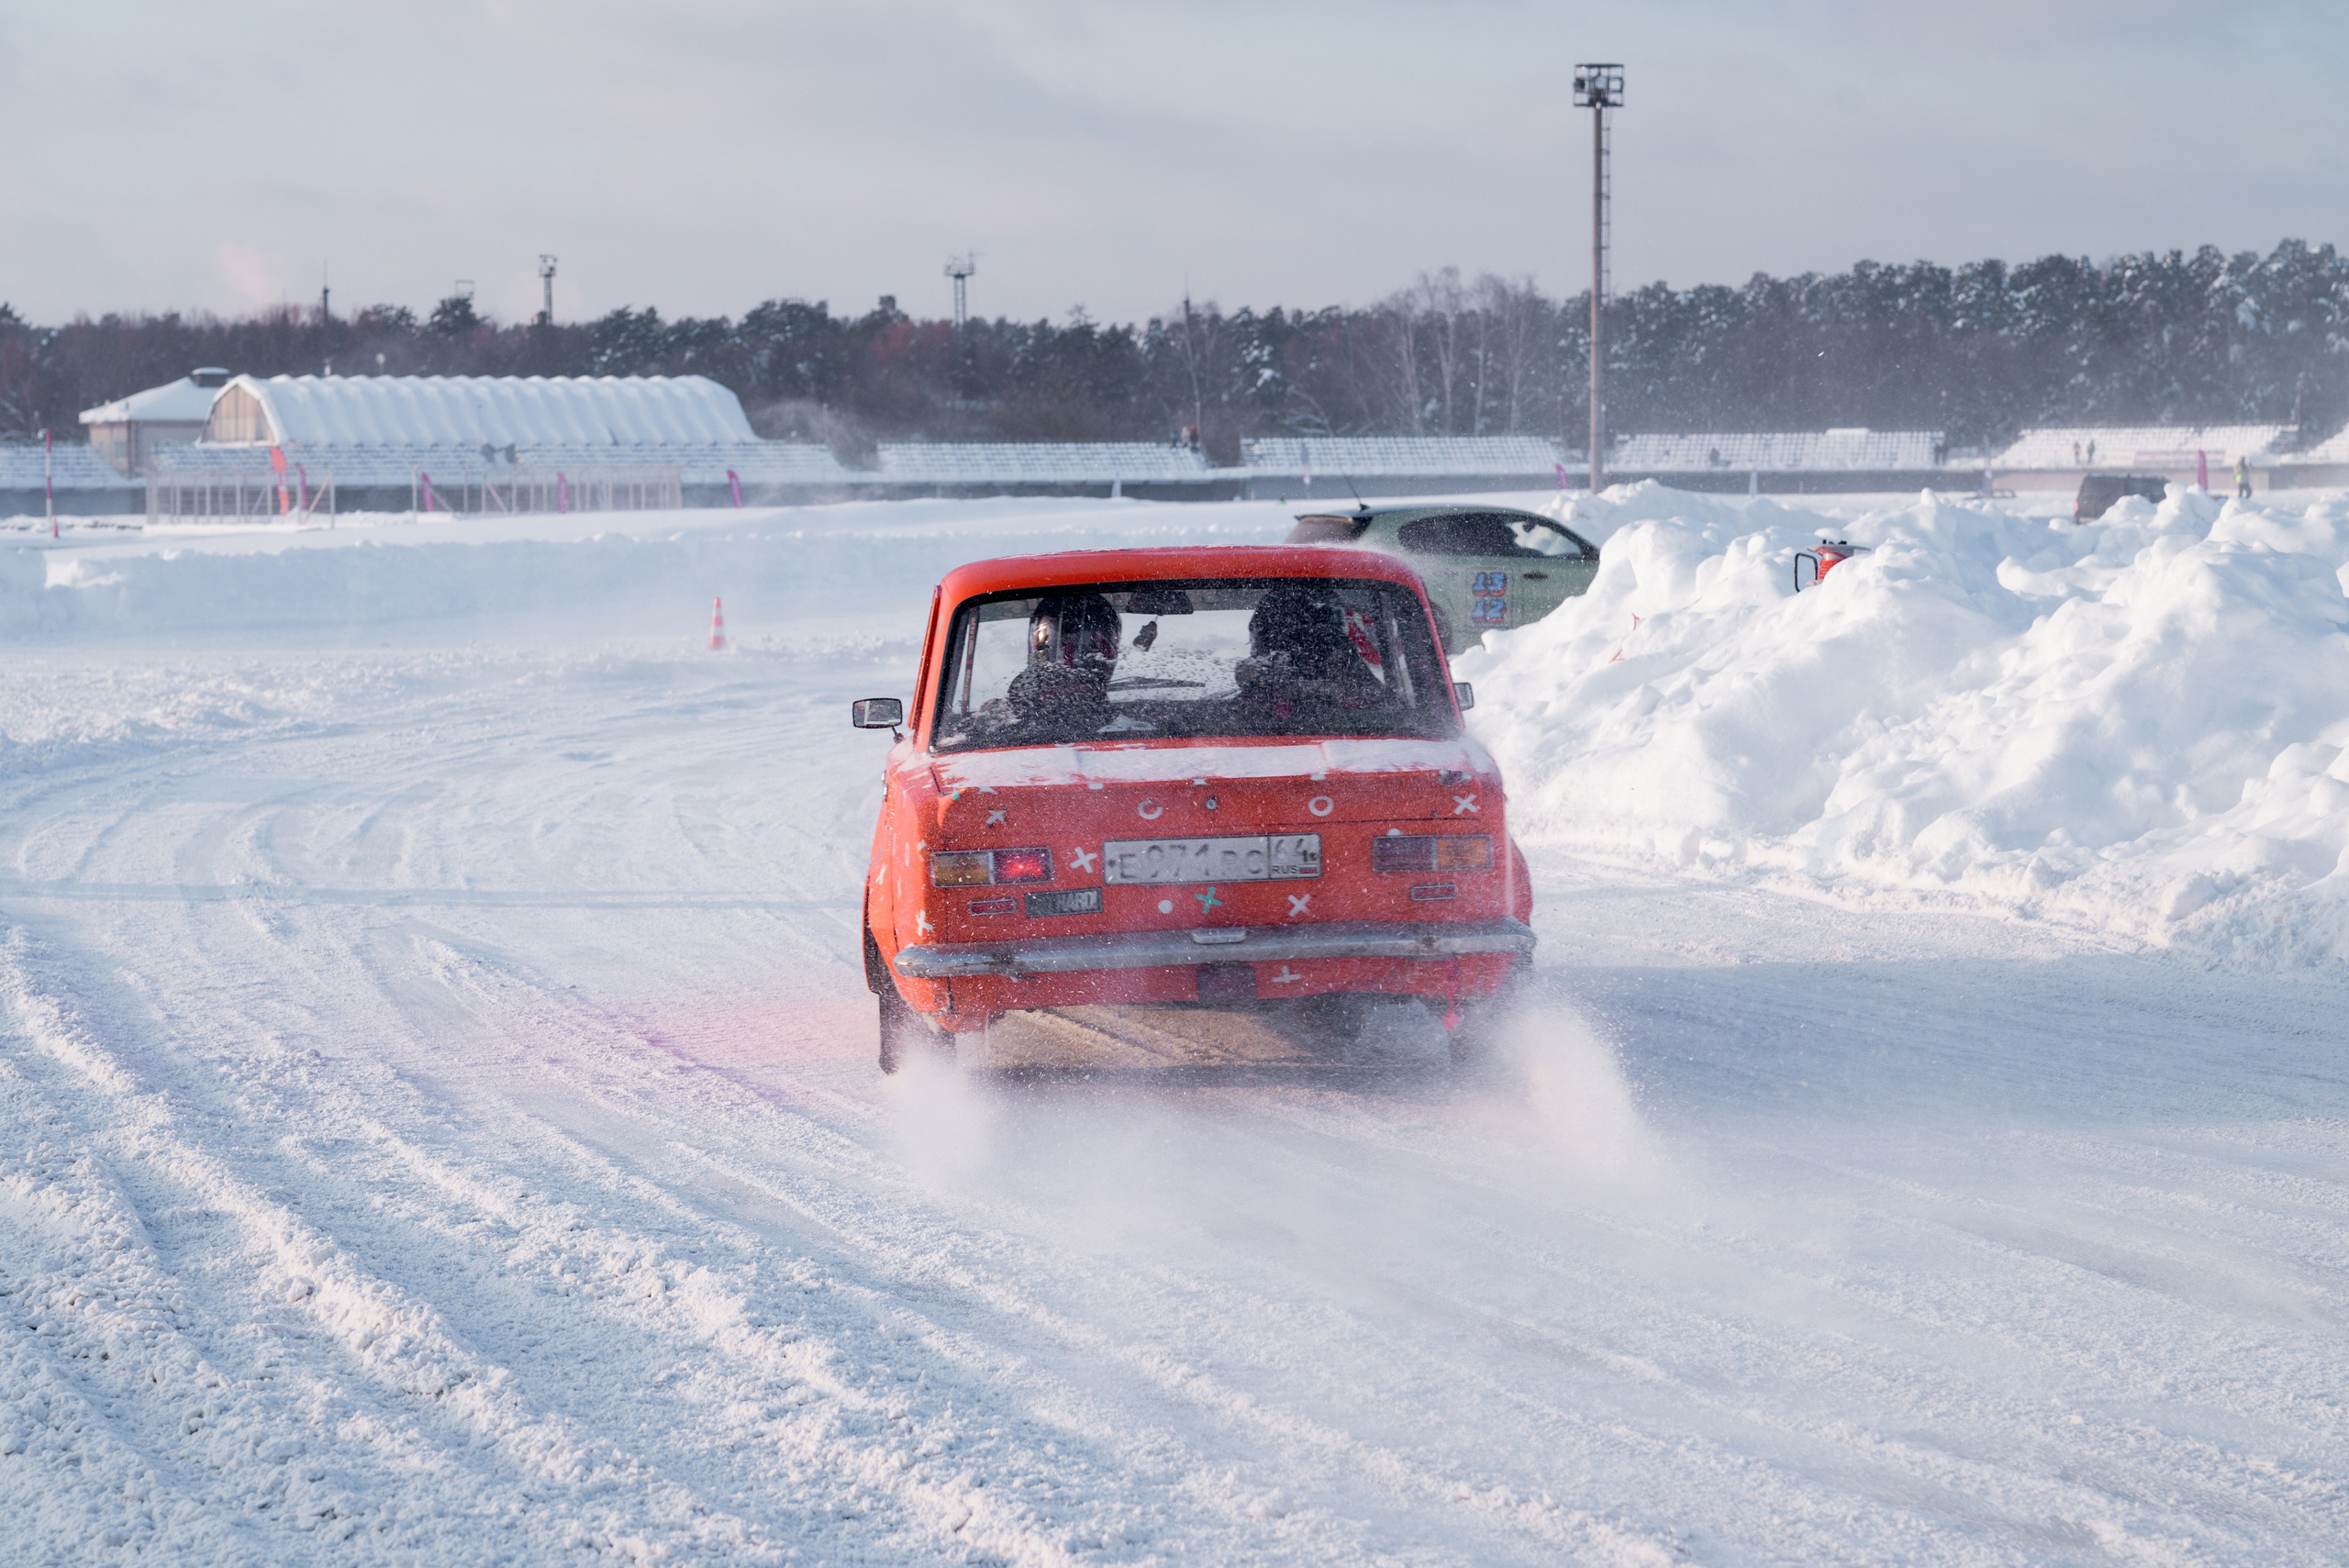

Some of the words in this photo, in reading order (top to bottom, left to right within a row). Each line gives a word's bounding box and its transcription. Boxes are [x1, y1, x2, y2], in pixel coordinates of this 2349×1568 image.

[1472, 572, 1508, 596] 13
[1472, 599, 1507, 624] 12
[1272, 864, 1299, 874] RUS
